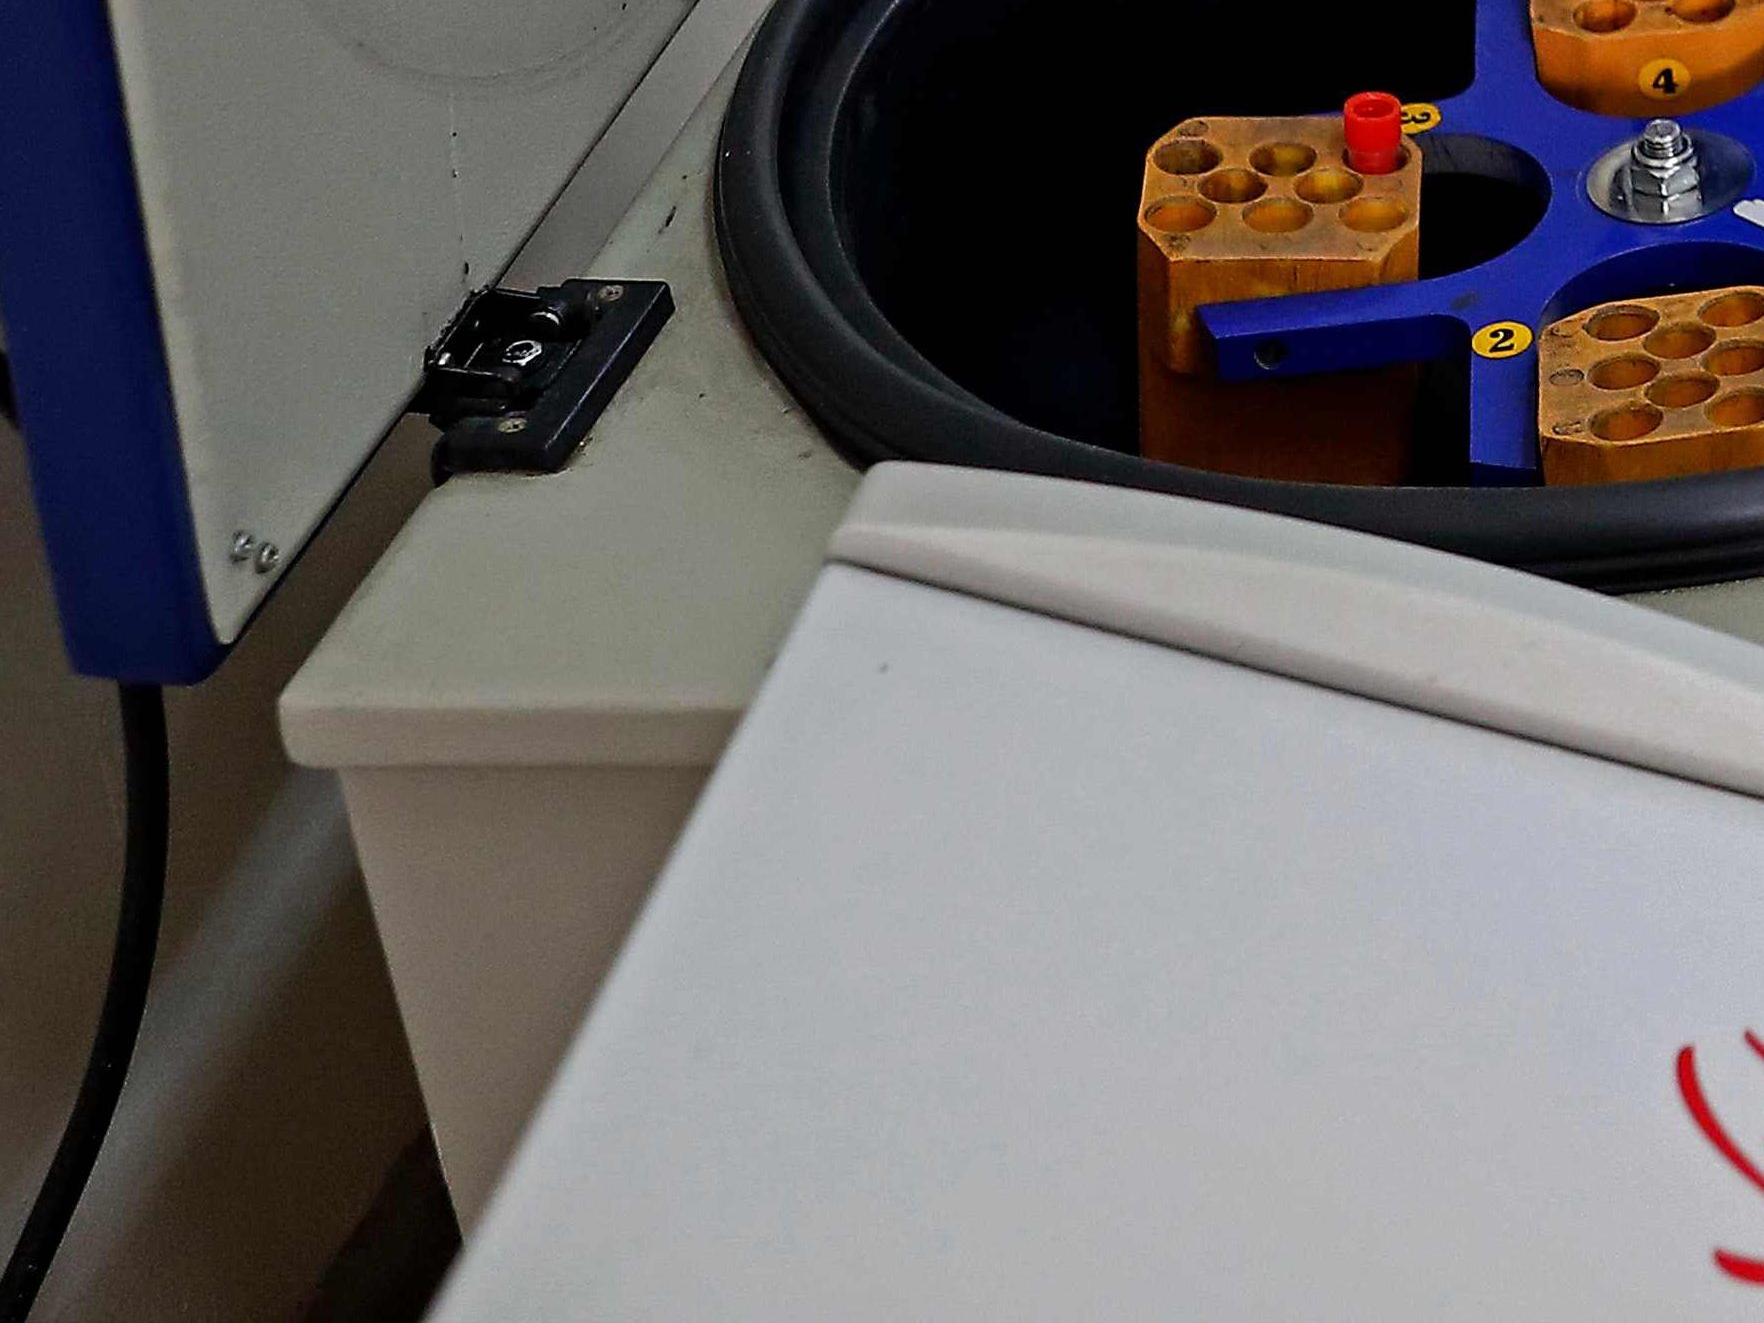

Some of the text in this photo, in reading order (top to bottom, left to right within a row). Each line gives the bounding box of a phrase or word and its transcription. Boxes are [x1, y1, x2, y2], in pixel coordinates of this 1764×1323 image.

[1651, 67, 1679, 95] 4
[1401, 111, 1432, 124] 3
[1487, 327, 1516, 354] 2
